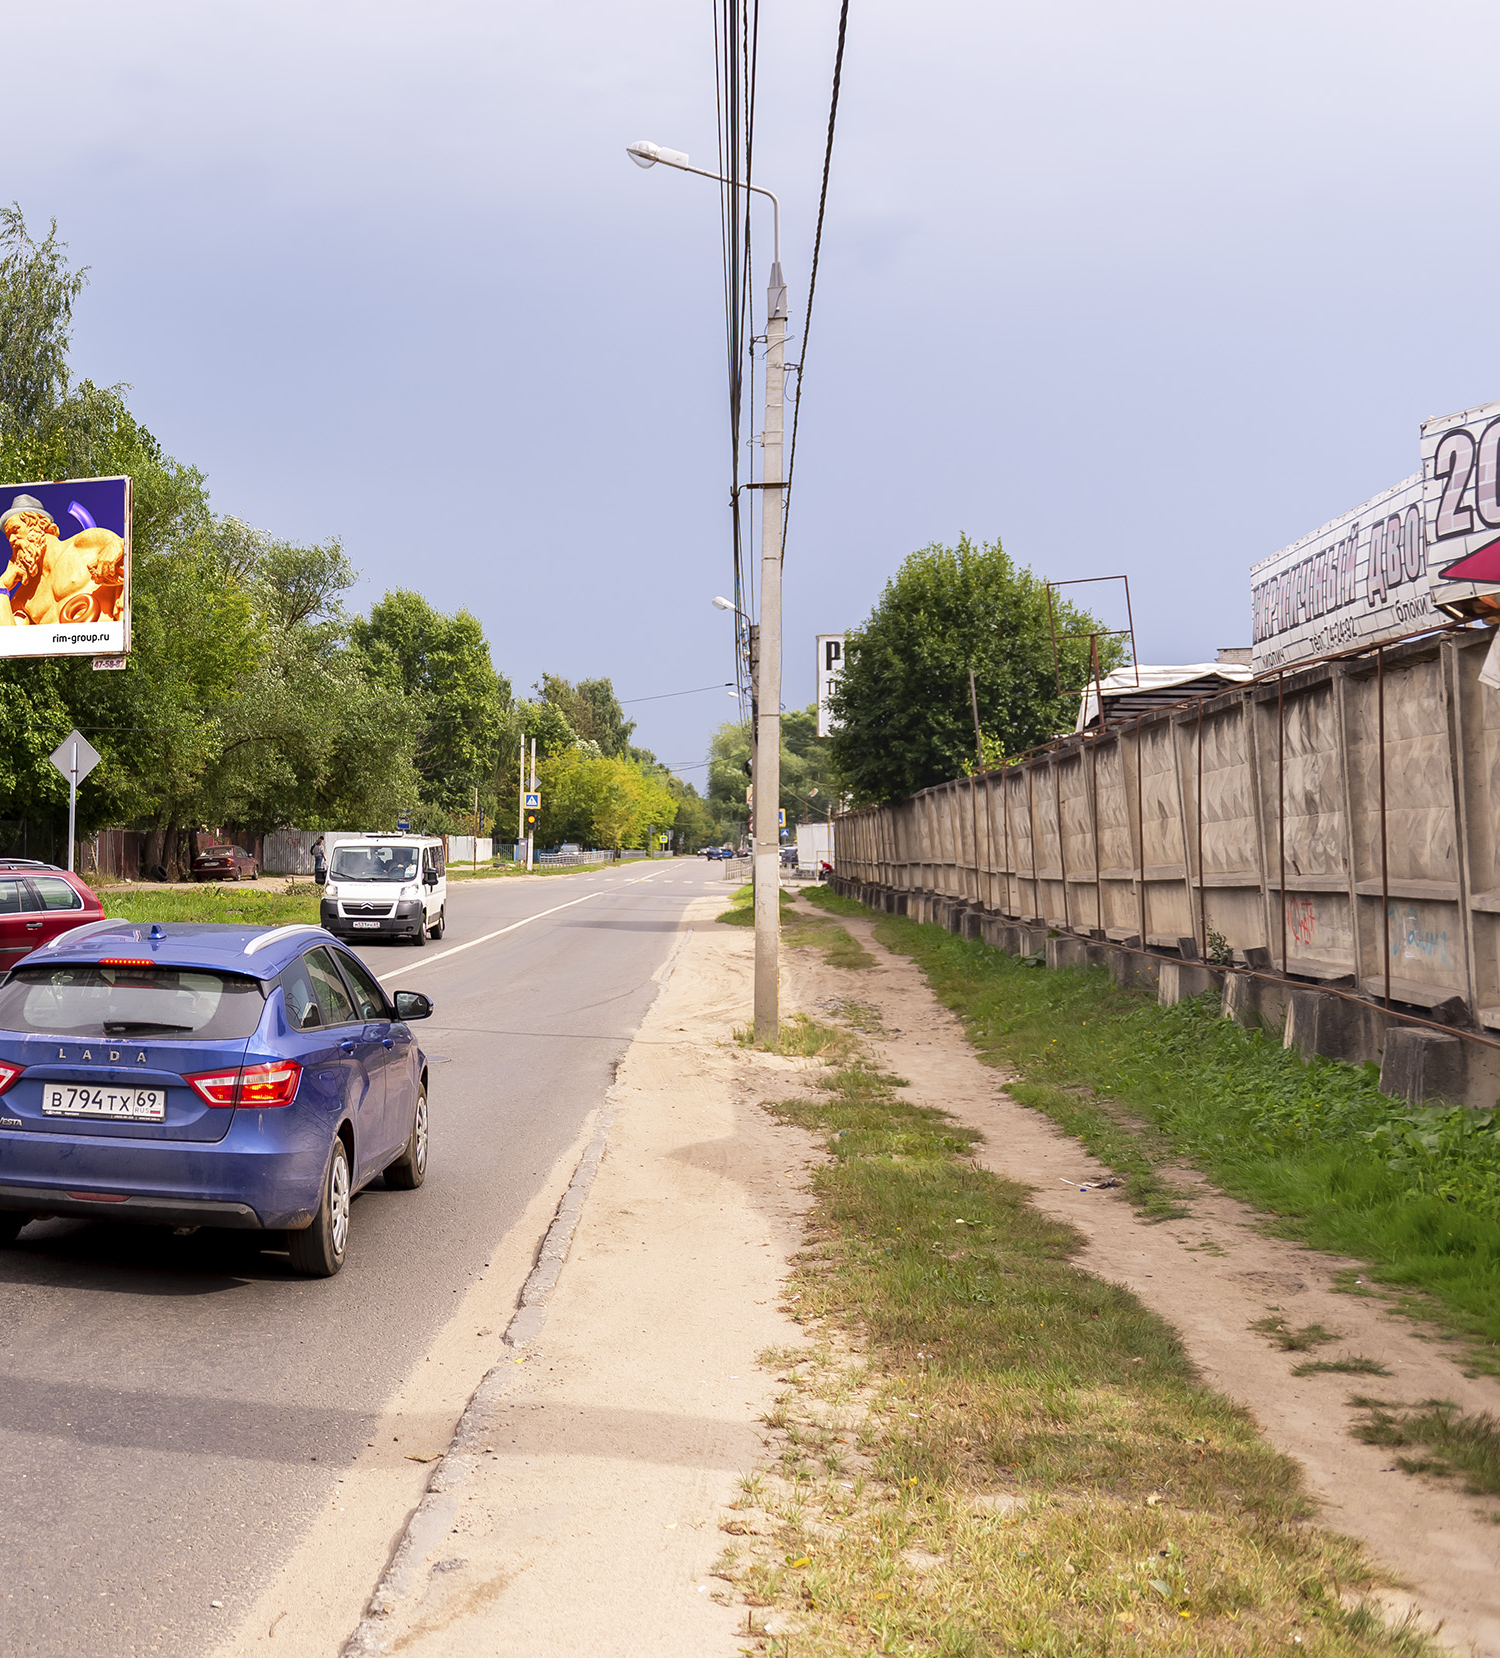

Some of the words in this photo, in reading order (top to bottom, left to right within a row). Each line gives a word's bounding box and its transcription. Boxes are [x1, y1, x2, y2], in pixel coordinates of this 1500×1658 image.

[1366, 503, 1427, 607] ДВО
[52, 634, 110, 644] rim-group.ru
[59, 1048, 147, 1062] LADA
[136, 1091, 157, 1107] 69
